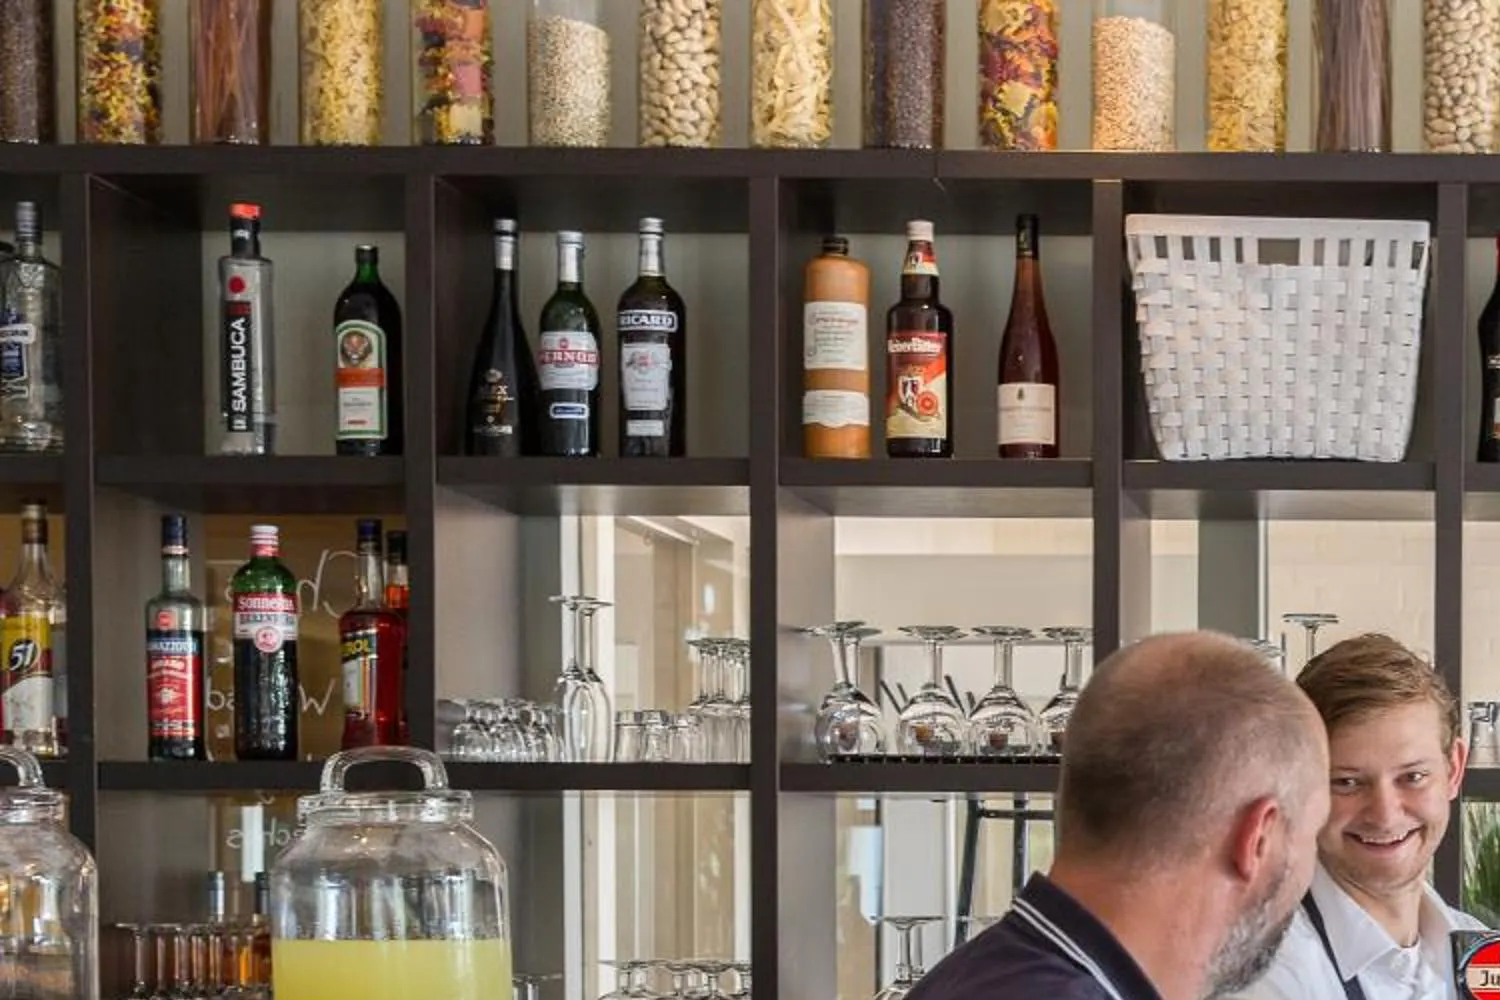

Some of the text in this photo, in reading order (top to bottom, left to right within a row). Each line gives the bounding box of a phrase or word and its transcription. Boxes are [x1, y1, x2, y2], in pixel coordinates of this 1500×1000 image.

[619, 313, 673, 327] RICARD
[230, 316, 247, 412] SAMBUCA
[10, 640, 35, 672] 51
